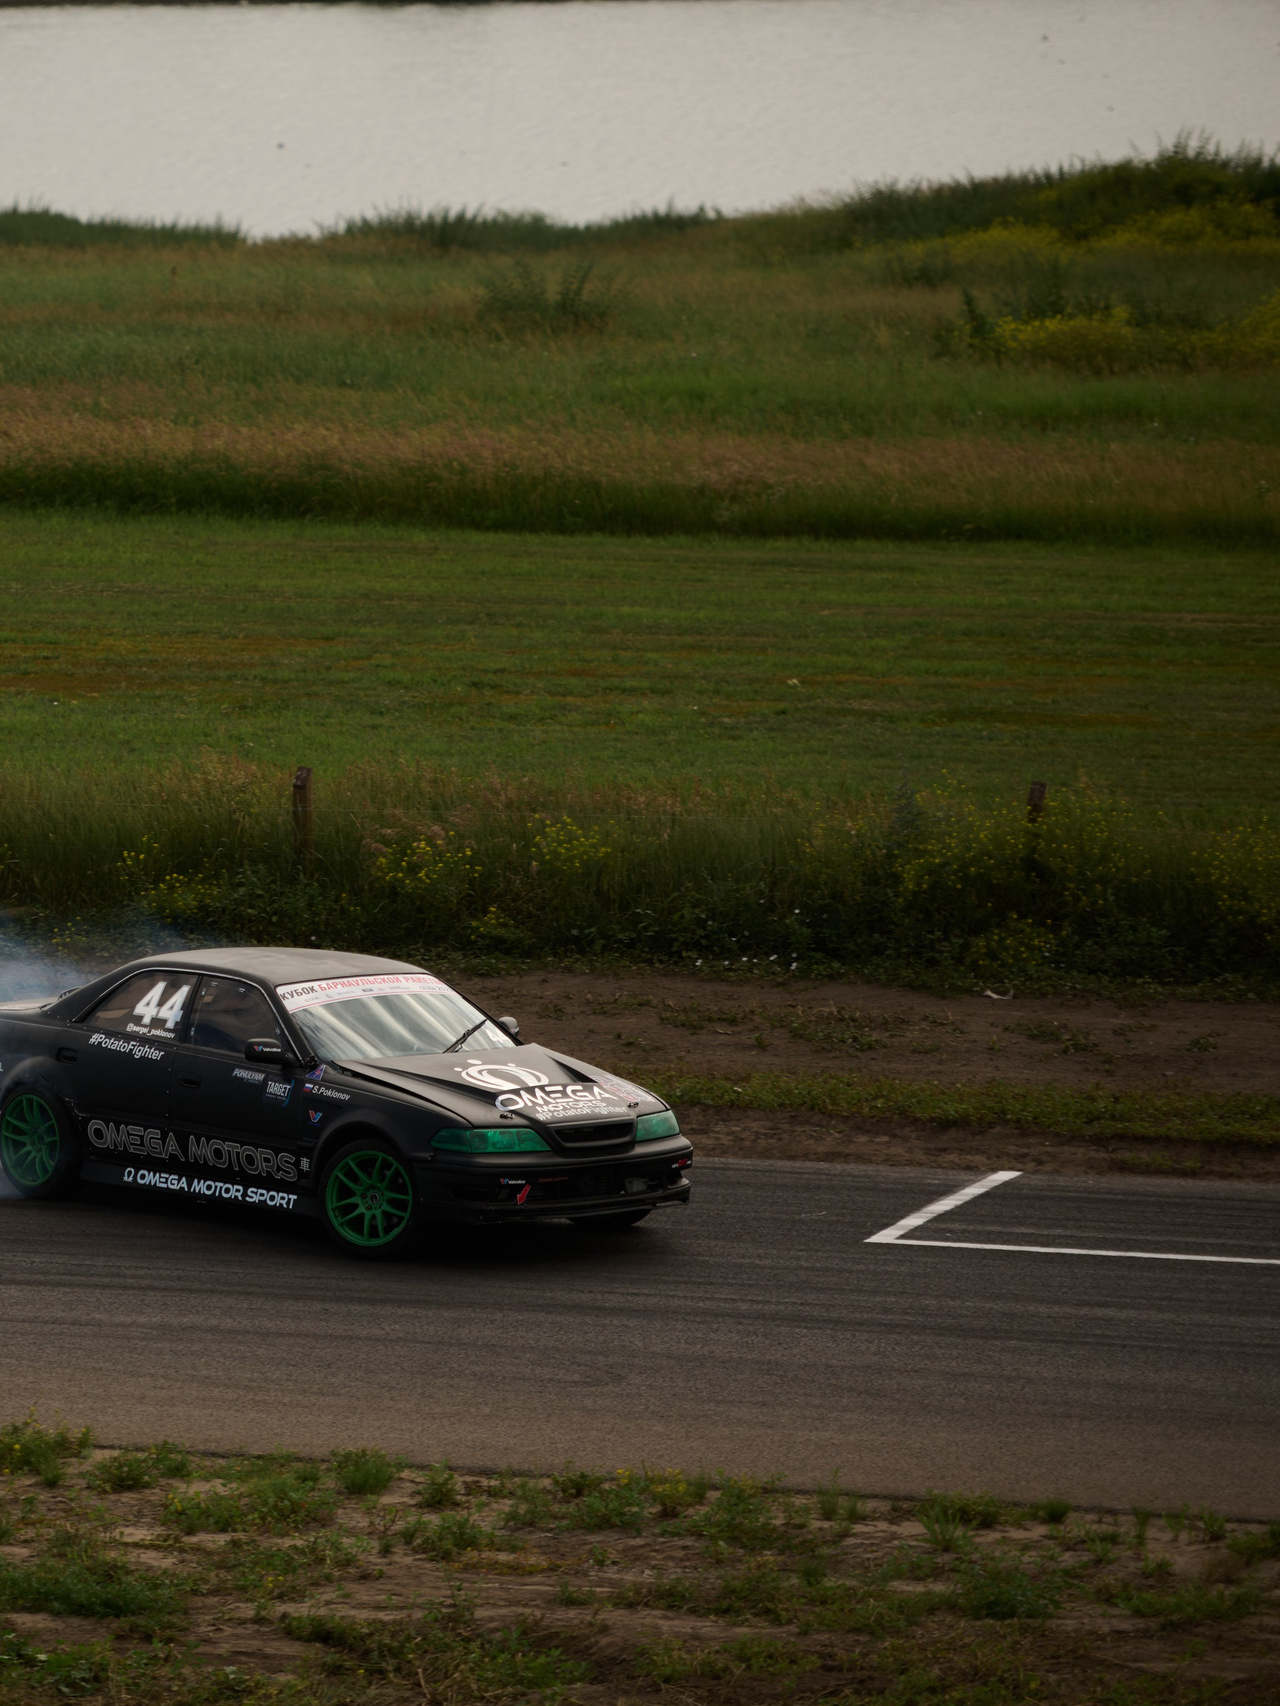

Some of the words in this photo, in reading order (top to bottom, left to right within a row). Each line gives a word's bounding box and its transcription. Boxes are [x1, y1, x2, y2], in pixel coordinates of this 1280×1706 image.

[280, 985, 319, 1001] КУБОК
[132, 981, 191, 1030] 44
[88, 1032, 165, 1061] #PotatoFighter
[266, 1081, 291, 1097] TARGET
[312, 1085, 351, 1101] S.Poklonov
[495, 1085, 619, 1112] OMEGA
[535, 1106, 629, 1121] #PotatoFighter
[536, 1100, 607, 1114] MOTORS
[87, 1119, 186, 1162] OMEGA
[188, 1135, 298, 1182] MOTORS
[136, 1169, 188, 1192] OMEGA
[190, 1178, 244, 1201] MOTOR
[245, 1187, 298, 1209] SPORT
